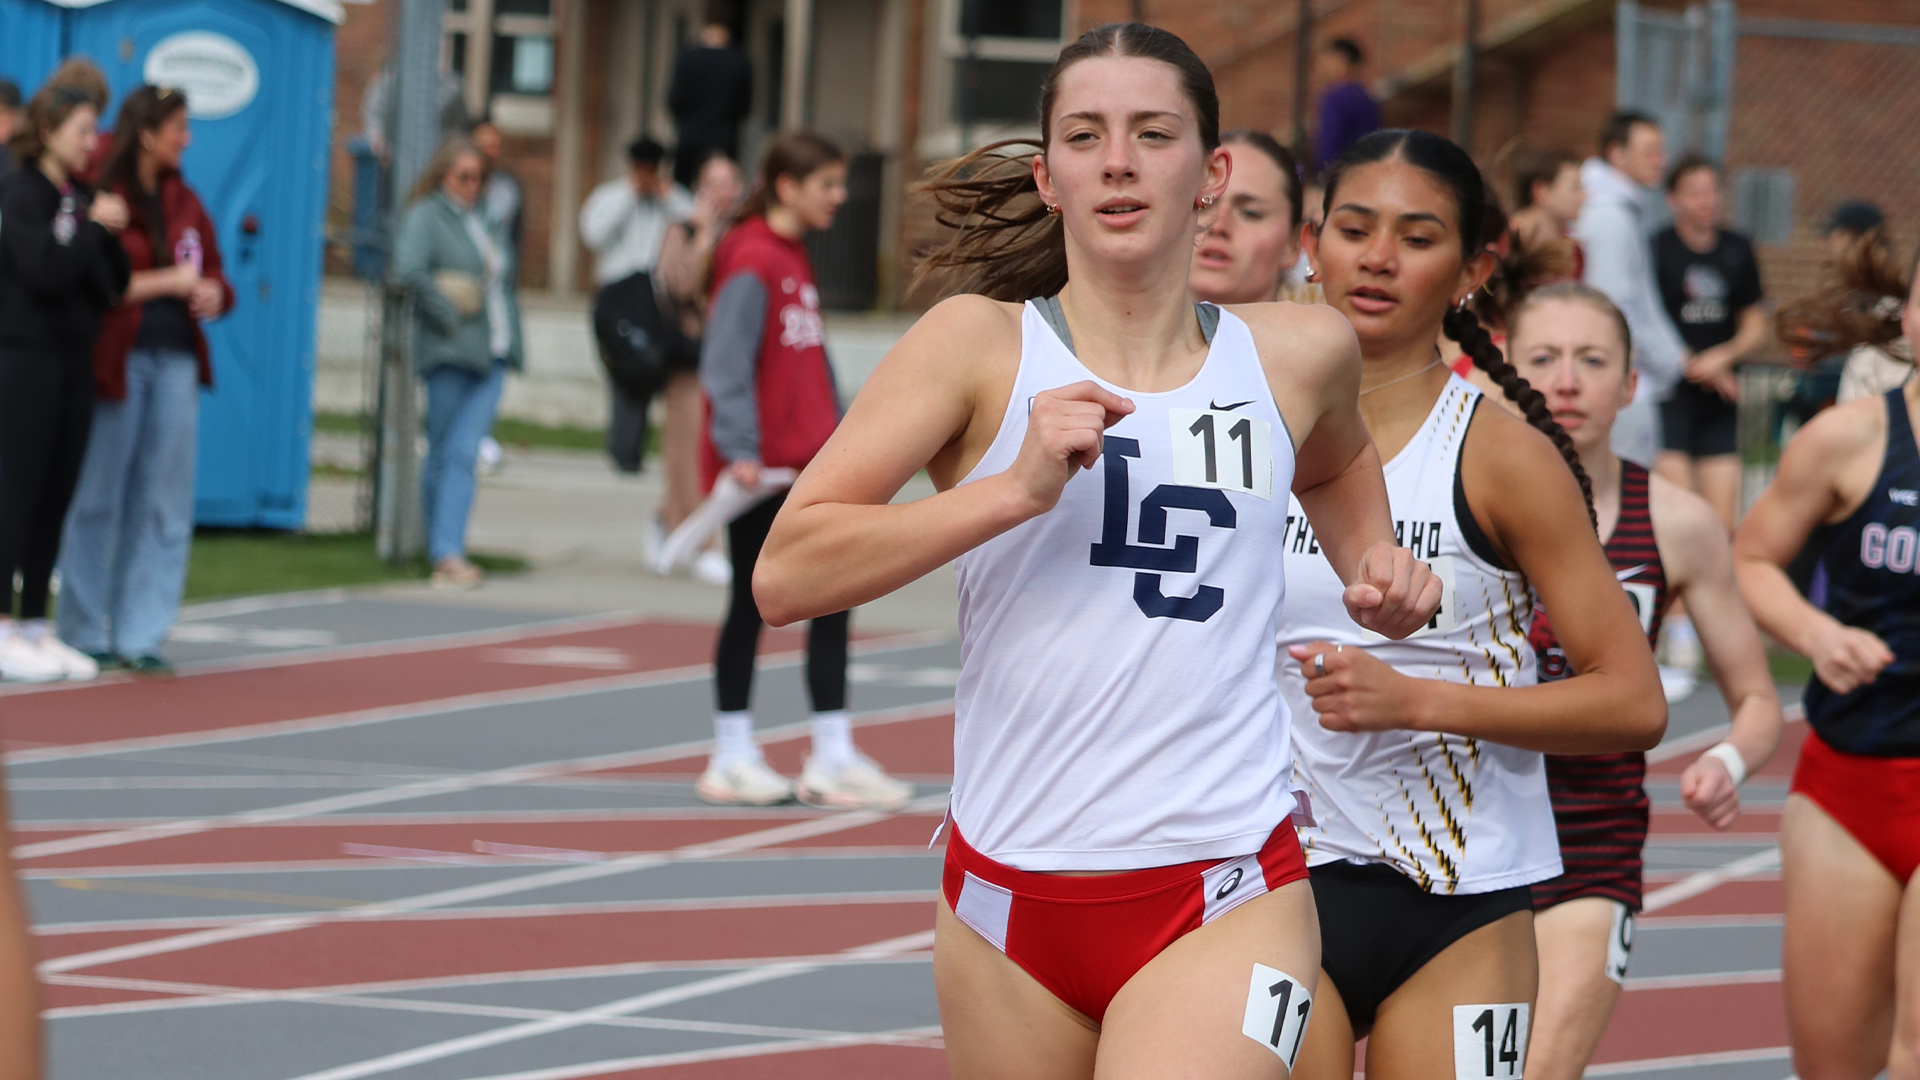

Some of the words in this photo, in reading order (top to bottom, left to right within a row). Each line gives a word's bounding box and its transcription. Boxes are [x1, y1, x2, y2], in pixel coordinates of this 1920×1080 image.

[1189, 413, 1253, 490] 11
[1090, 434, 1237, 623] LC
[1860, 522, 1920, 576] GO
[1268, 979, 1311, 1068] 11
[1471, 1008, 1518, 1077] 14
